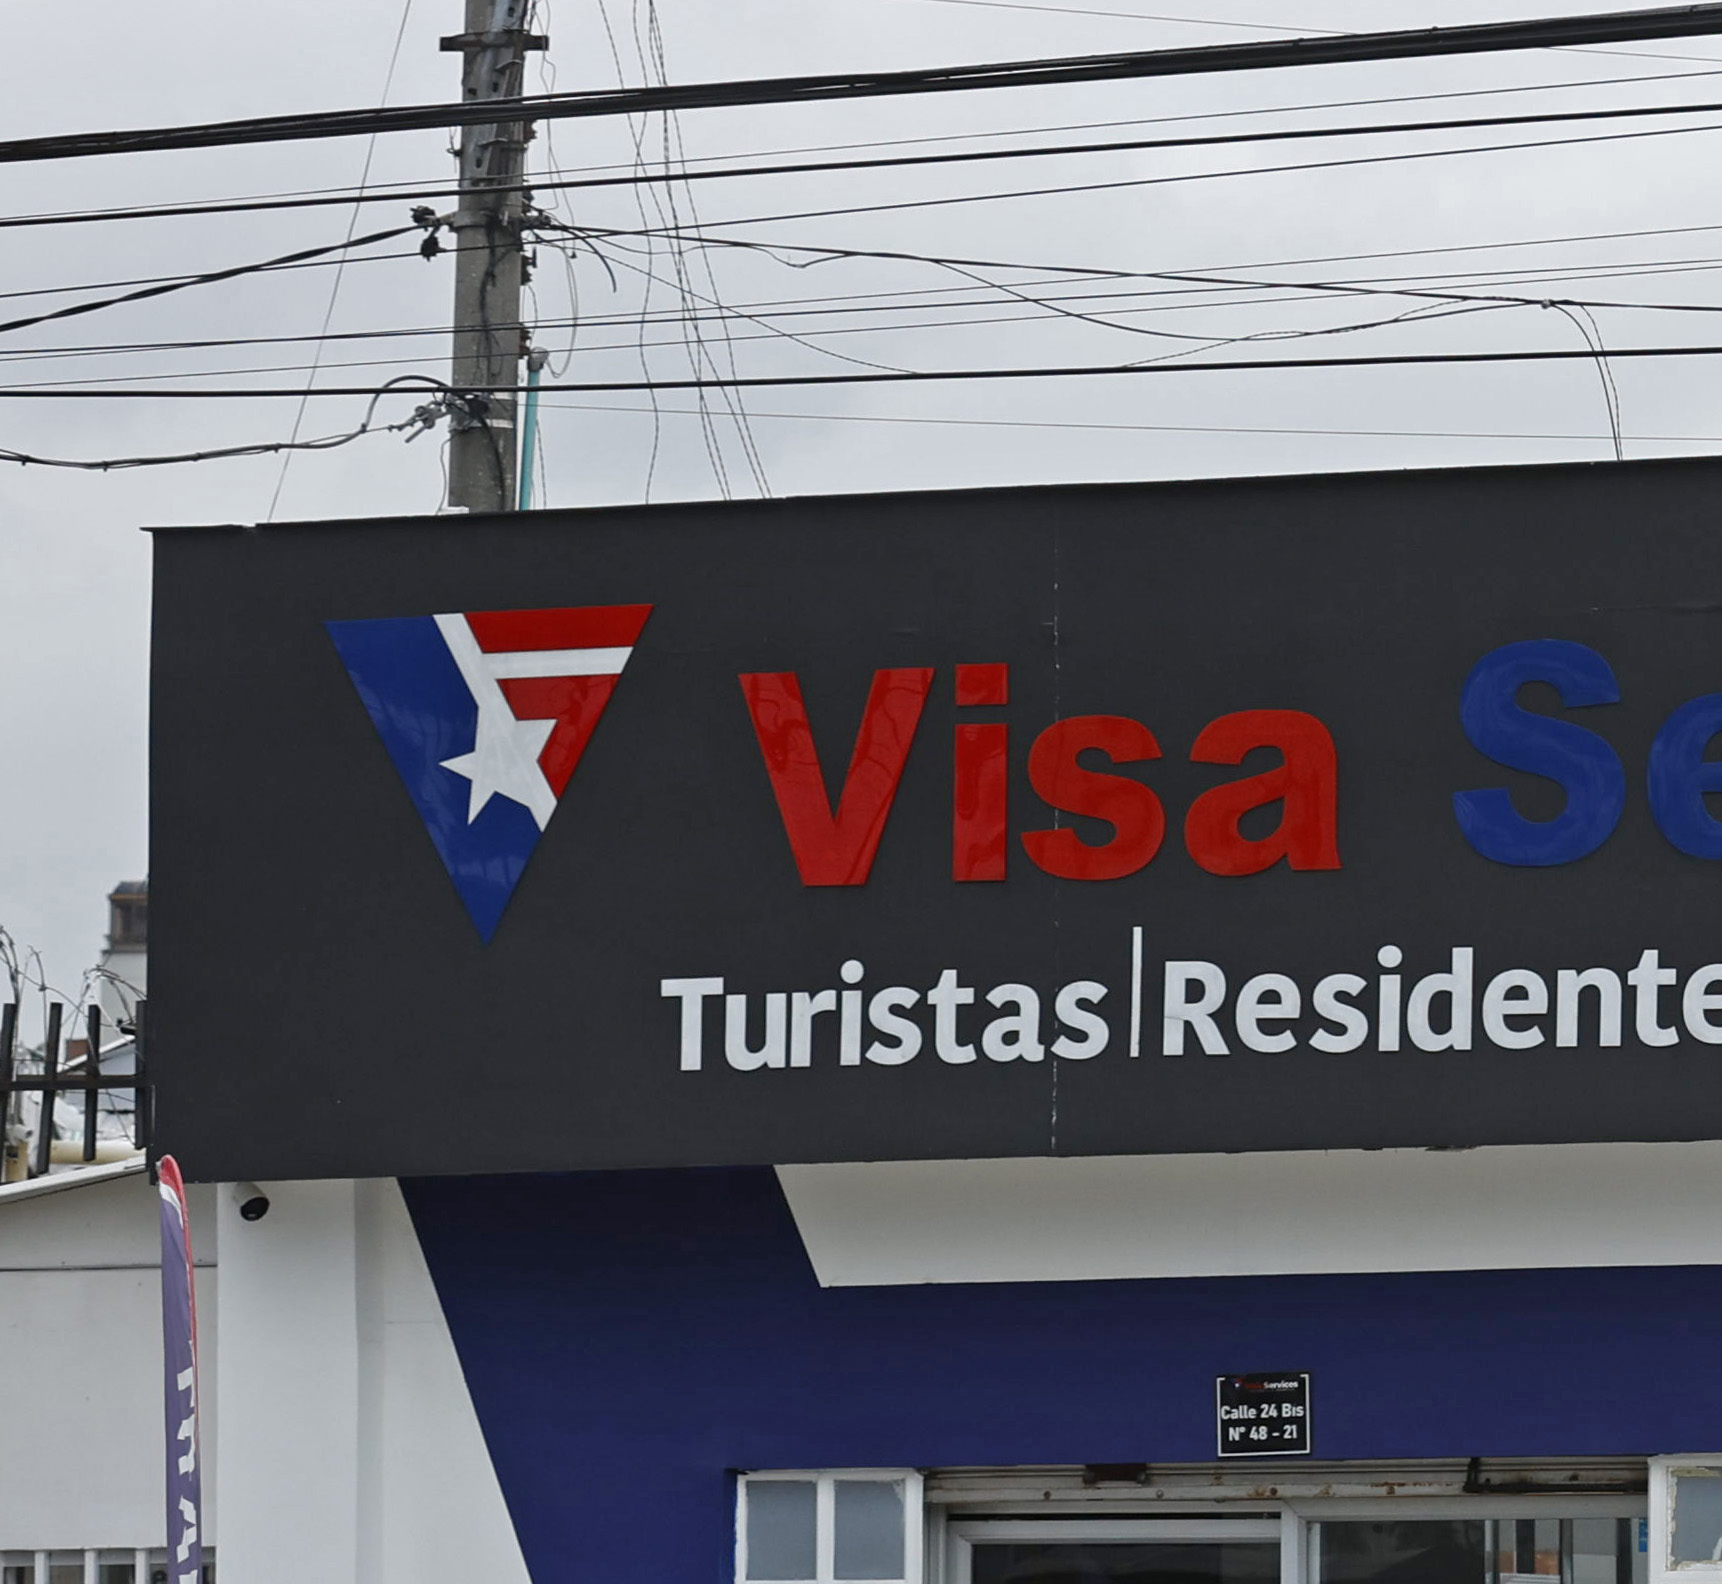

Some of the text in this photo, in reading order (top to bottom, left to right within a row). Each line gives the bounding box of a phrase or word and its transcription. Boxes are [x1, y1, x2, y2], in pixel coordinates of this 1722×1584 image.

[737, 661, 1343, 888] Visa
[659, 958, 1111, 1072] Turistas
[1221, 1403, 1305, 1420] Calle 24 Bis
[1249, 1425, 1268, 1440] 48
[1283, 1424, 1298, 1439] 21
